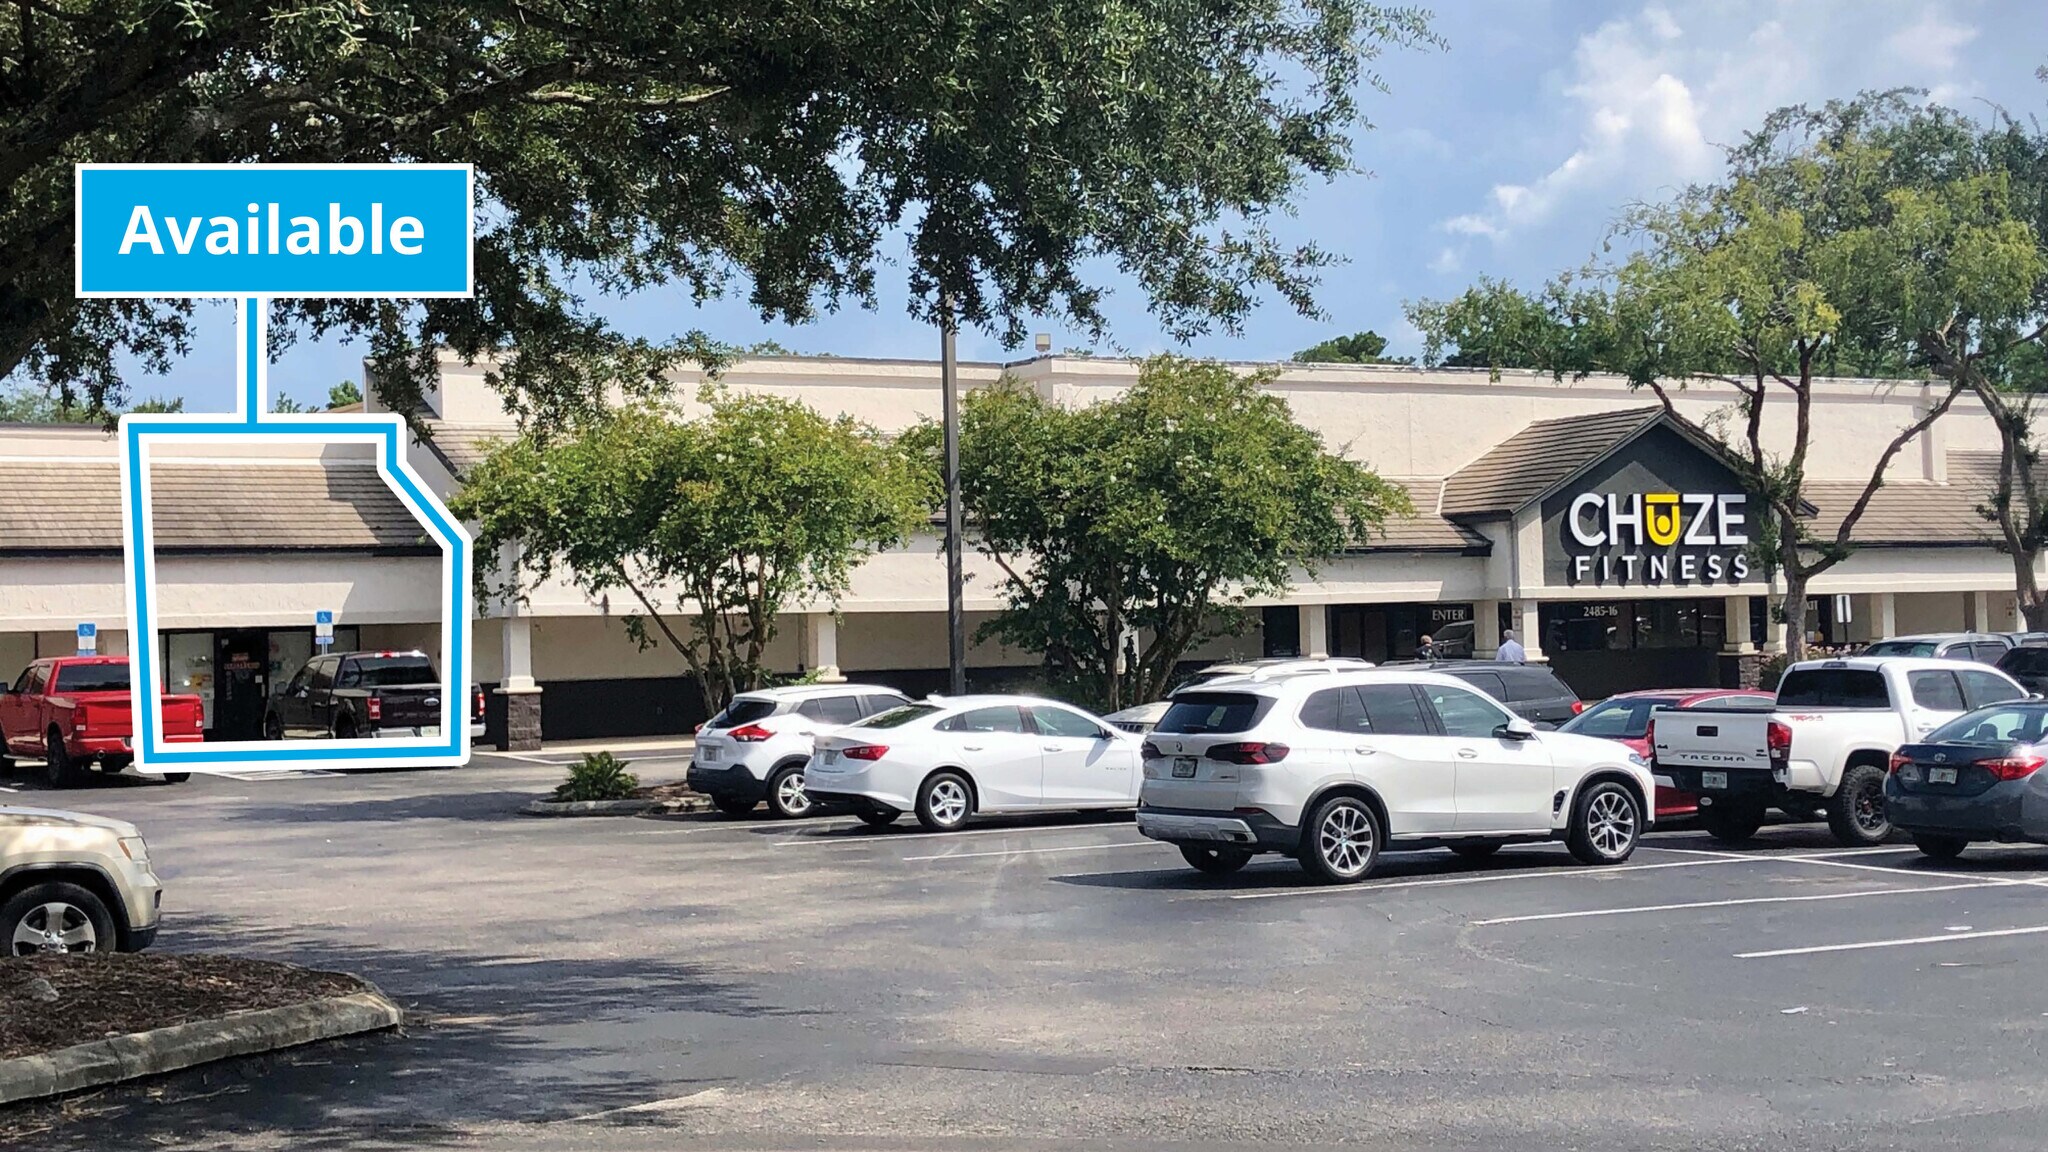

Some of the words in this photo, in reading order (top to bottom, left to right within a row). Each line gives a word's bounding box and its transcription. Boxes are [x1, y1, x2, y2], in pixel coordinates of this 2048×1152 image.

[1569, 492, 1749, 547] CHUZE
[1575, 554, 1749, 580] FITNESS
[1432, 609, 1464, 621] ENTER
[1583, 605, 1618, 617] 2485-16
[1680, 754, 1746, 762] TACOMA
